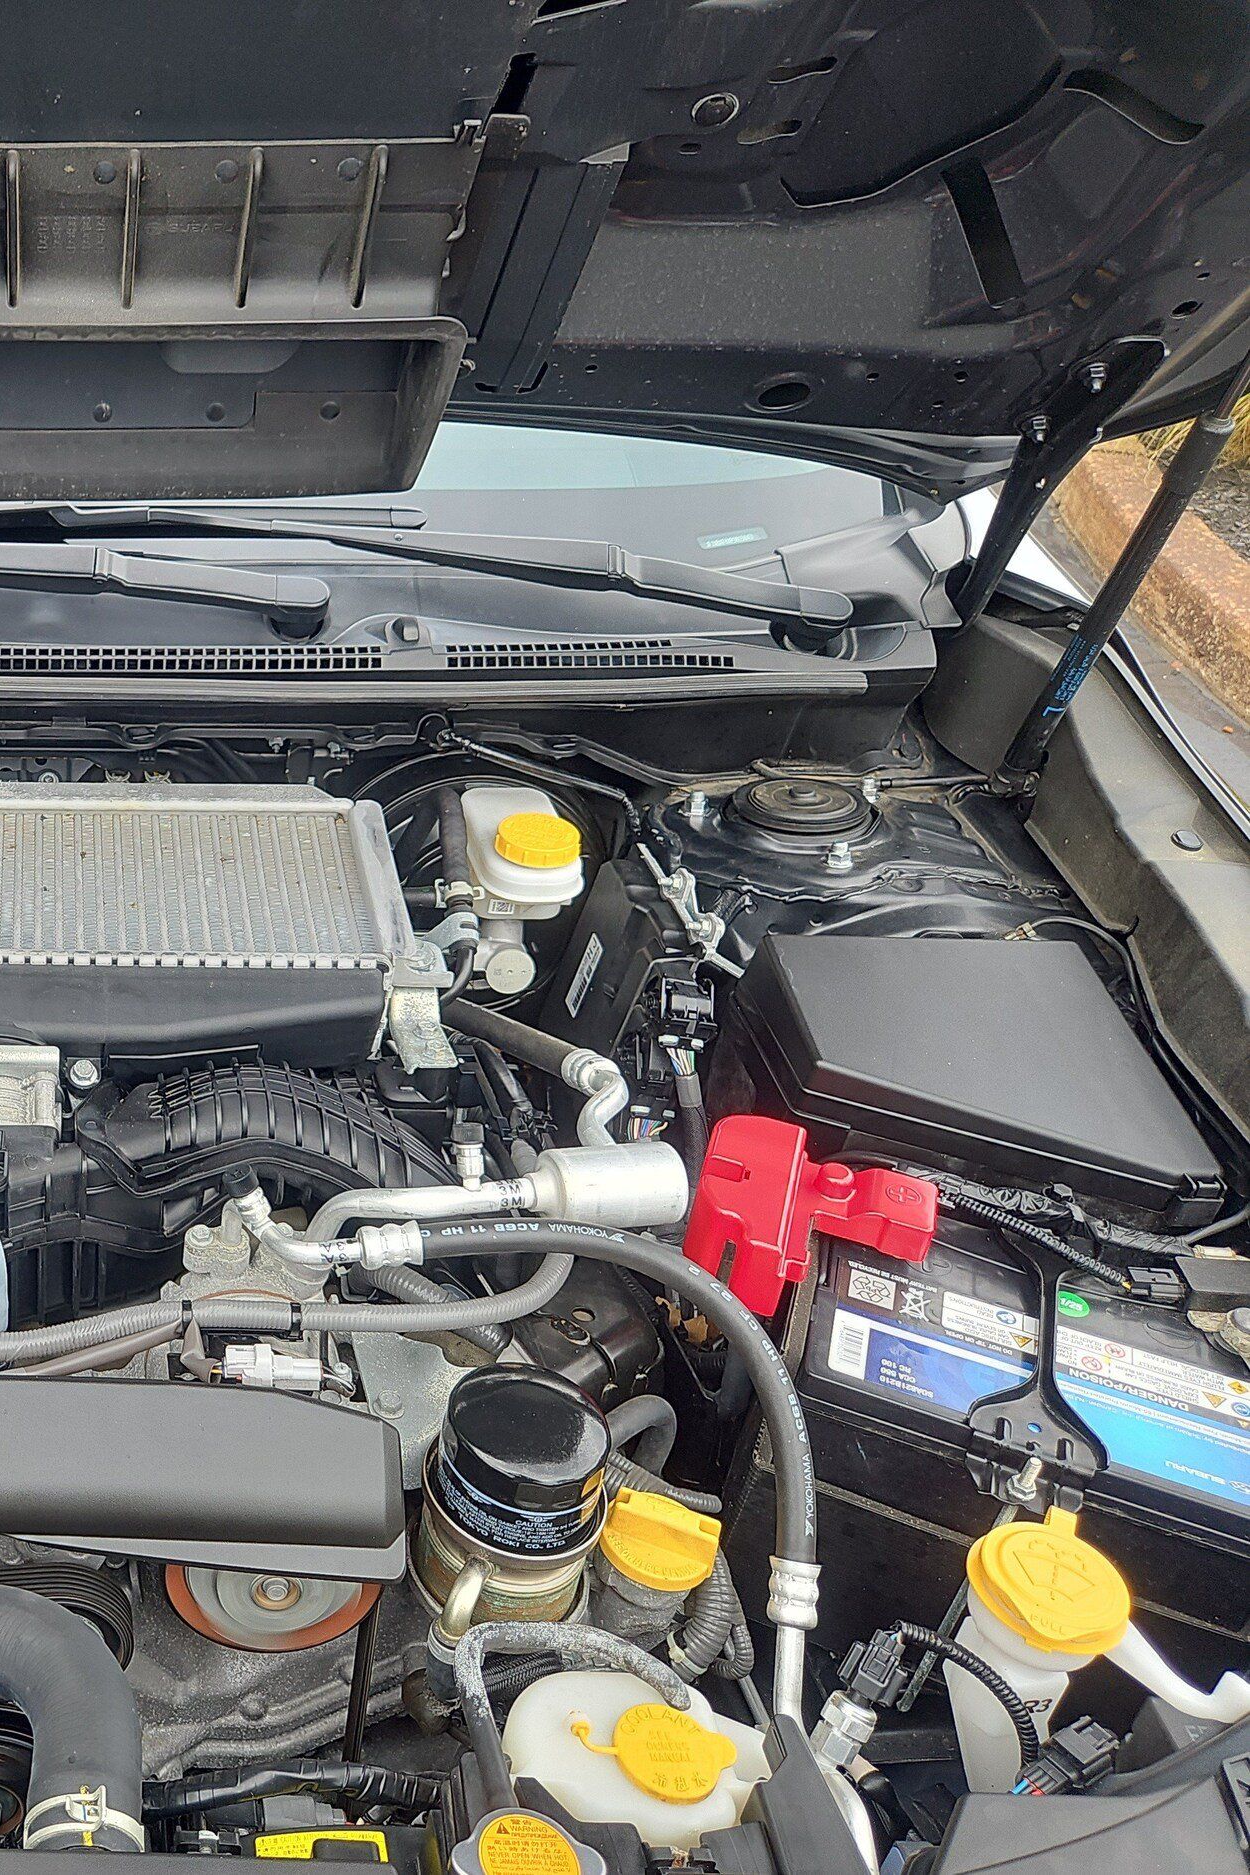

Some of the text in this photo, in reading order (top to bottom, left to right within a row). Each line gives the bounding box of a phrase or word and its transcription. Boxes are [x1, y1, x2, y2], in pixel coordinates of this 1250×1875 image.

[442, 1226, 468, 1237] HP
[548, 1223, 608, 1239] YOKOHAMA
[890, 1273, 908, 1283] MUST
[761, 1339, 778, 1362] HP
[987, 1343, 1001, 1351] NOT
[1002, 1347, 1012, 1355] DO
[1068, 1368, 1190, 1412] DANGER/POISON
[1164, 1459, 1227, 1485] SUBARU
[800, 1453, 816, 1519] YOKOHAMA
[458, 1512, 489, 1537] TOKYO
[493, 1535, 520, 1547] ROKI
[515, 1519, 553, 1528] CAUTION
[620, 1706, 701, 1736] COOLANT
[510, 1825, 548, 1833] WARNING
